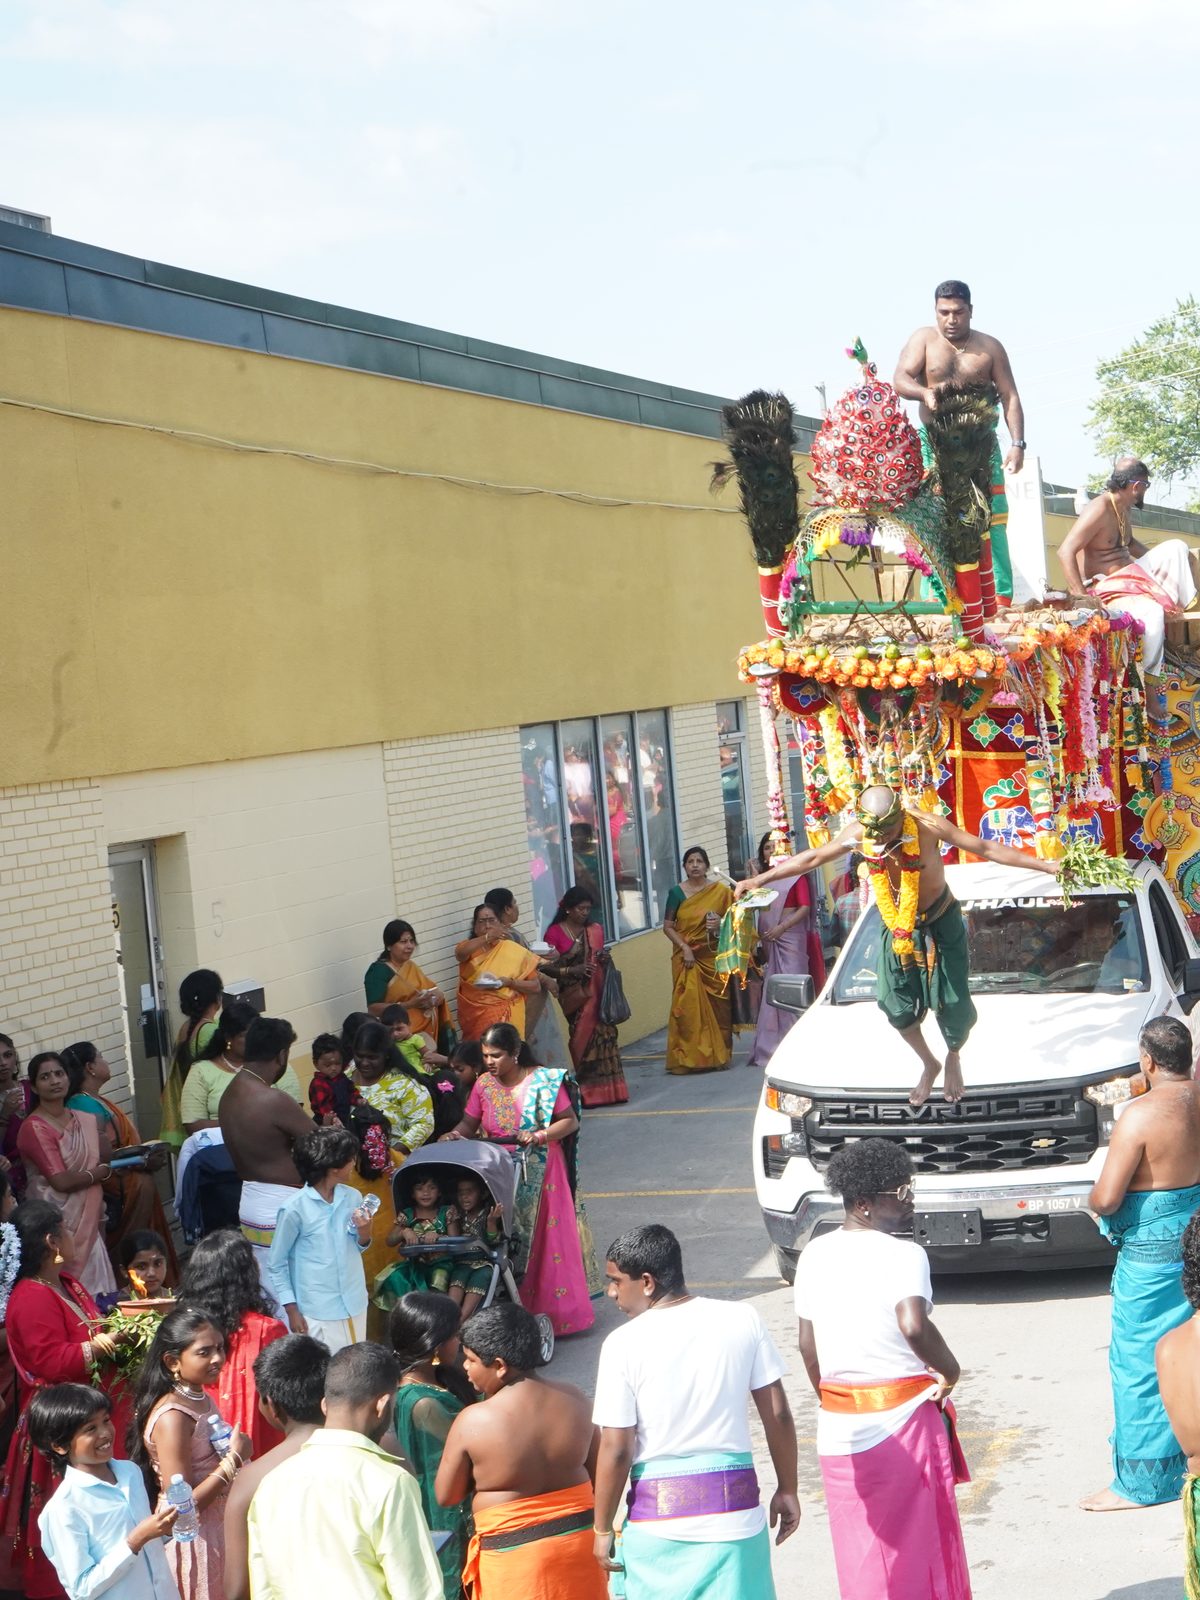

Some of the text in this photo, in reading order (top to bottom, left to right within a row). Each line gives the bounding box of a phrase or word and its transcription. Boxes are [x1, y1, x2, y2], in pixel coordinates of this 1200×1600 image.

[211, 901, 224, 938] 5
[824, 1094, 1073, 1120] CHEVROLET
[1028, 1197, 1081, 1211] BP 1057 V
